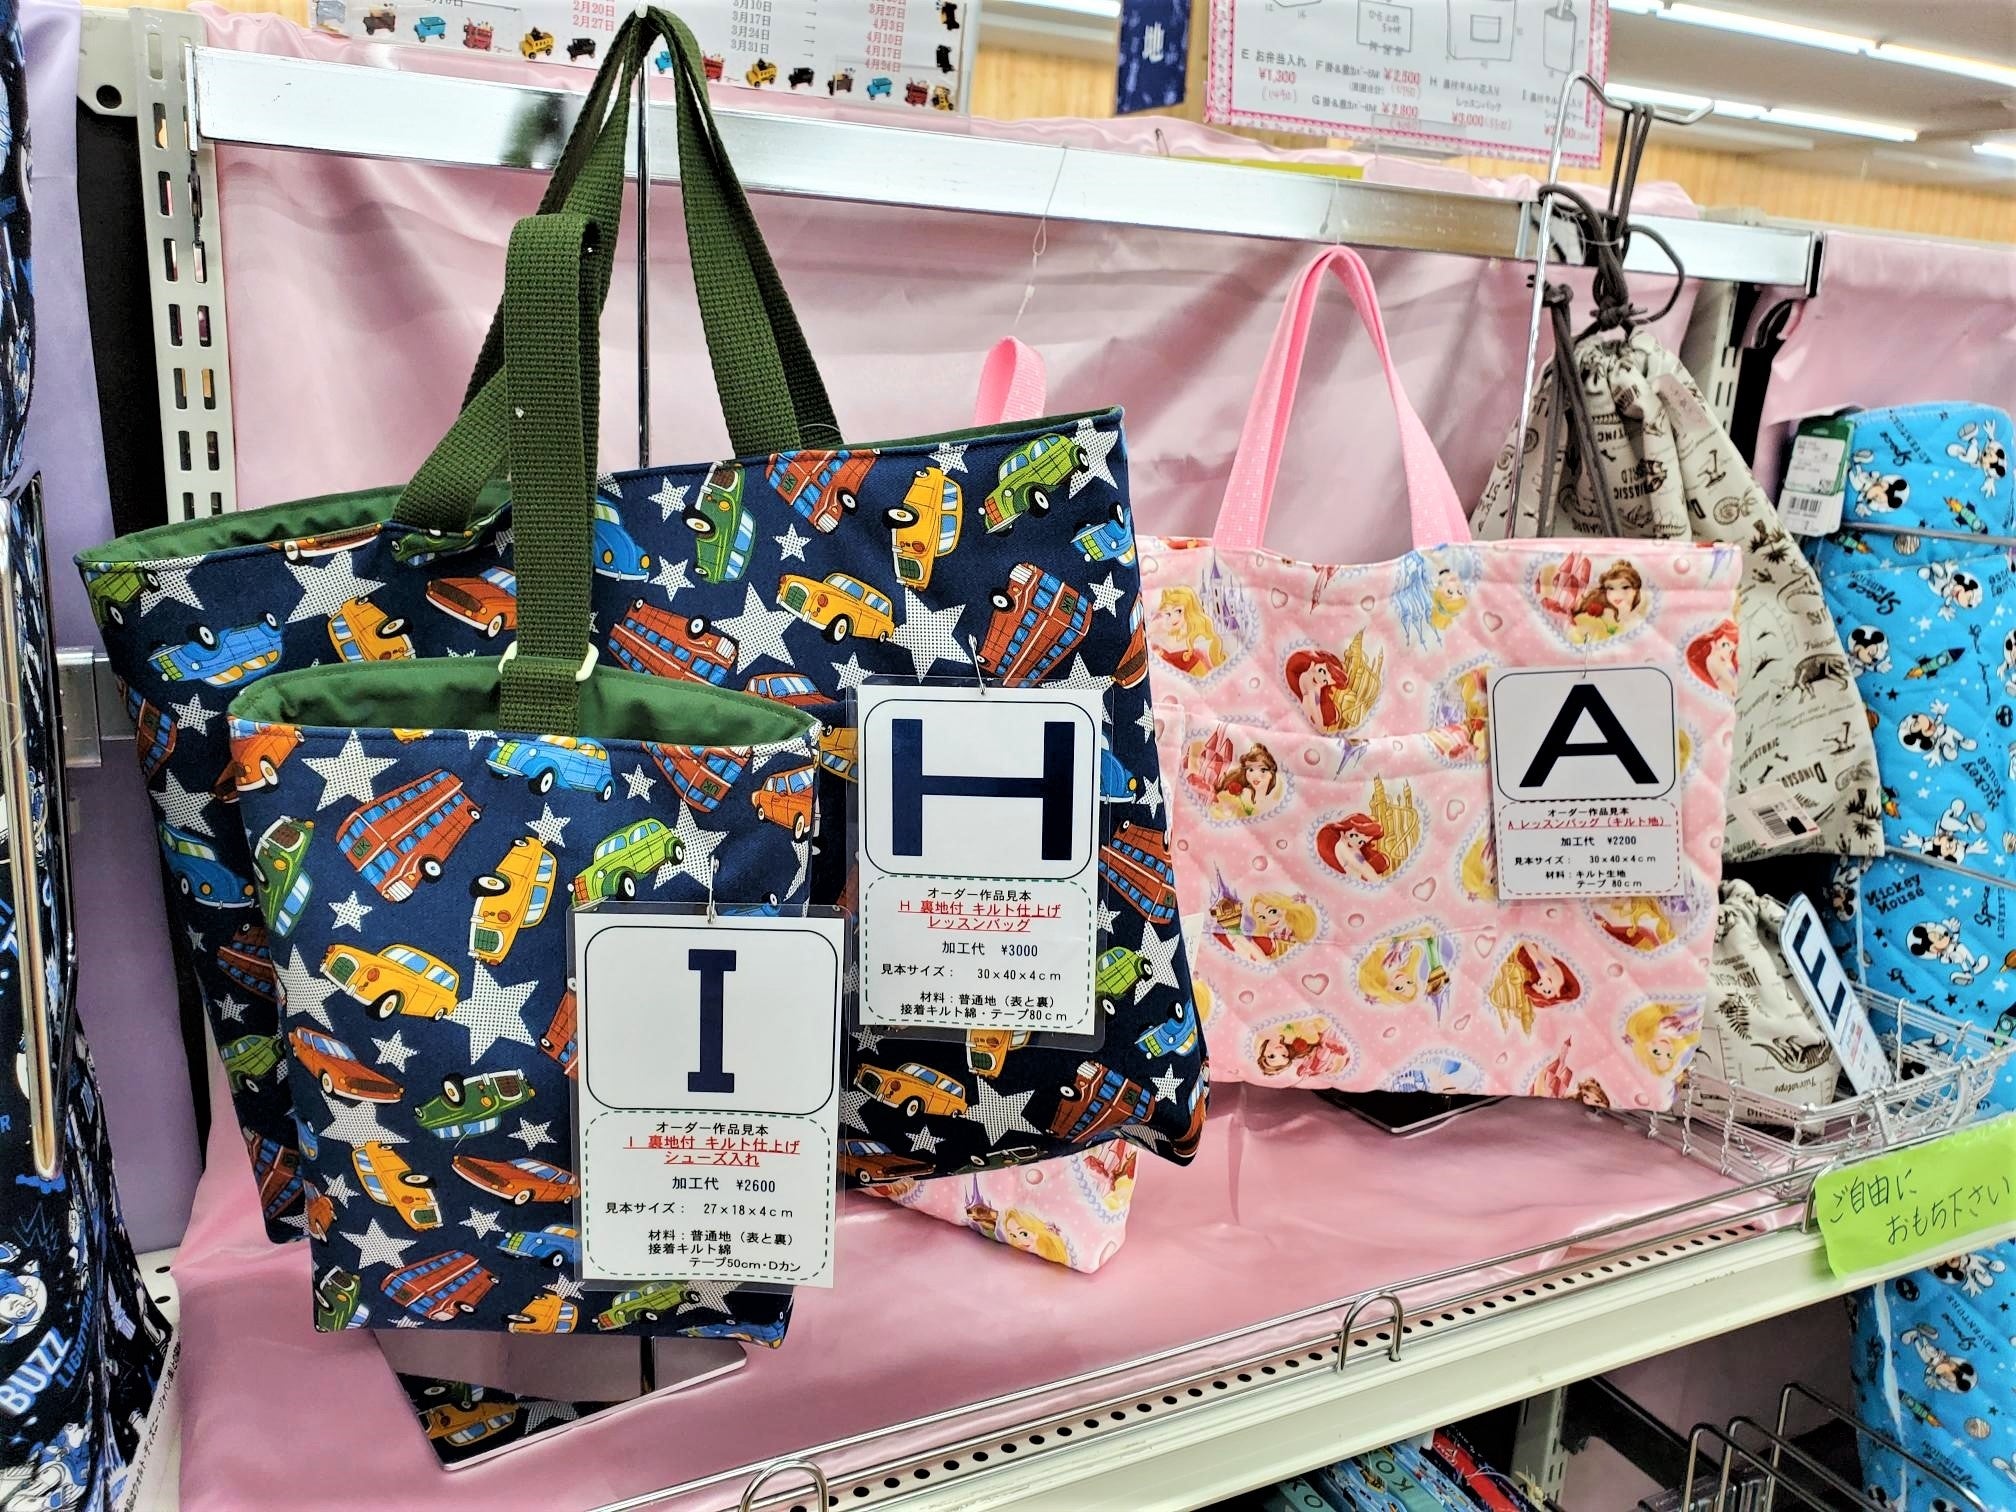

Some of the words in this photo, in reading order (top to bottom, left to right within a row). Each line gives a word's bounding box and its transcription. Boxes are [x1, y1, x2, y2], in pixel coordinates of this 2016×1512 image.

[572, 14, 614, 31] 2月27日
[732, 10, 771, 26] 3月17日
[731, 24, 770, 40] 3月24日
[730, 38, 769, 54] 3月31日
[1256, 50, 1307, 68] お弁当入れ
[1519, 684, 1660, 788] A
[1961, 760, 2000, 812] Mickey
[1976, 755, 2006, 801] Mouse
[892, 718, 1076, 861] H
[1548, 807, 1629, 817] オーダー作品見本
[1560, 836, 1595, 847] 加工代
[1607, 835, 1637, 846] ¥2200
[928, 887, 1032, 902] オーダー作品見本
[1865, 873, 1921, 906] Mickey
[900, 900, 911, 911] H
[920, 900, 964, 915] 裏地付
[972, 903, 1061, 918] キルト仕上げ
[1875, 886, 1926, 915] Mouse
[928, 916, 1031, 932] レッスンバッグ
[942, 941, 985, 956] 加工代
[1001, 944, 1038, 957] ¥3000
[1792, 912, 1847, 1035] E
[687, 948, 737, 1094] I
[655, 1121, 769, 1136] オーダー作品見本
[647, 1134, 696, 1150] 裏地付
[704, 1136, 800, 1153] キルト仕上げ
[664, 1151, 760, 1167] シューズ入れ
[672, 1176, 719, 1191] 加工代
[736, 1178, 776, 1193] ¥2600
[1830, 1168, 1917, 1224] ご自由に
[1886, 1175, 2011, 1246] おもち下さい
[647, 1243, 732, 1256] 接着キルト綿
[0, 1326, 73, 1417] BUZZ
